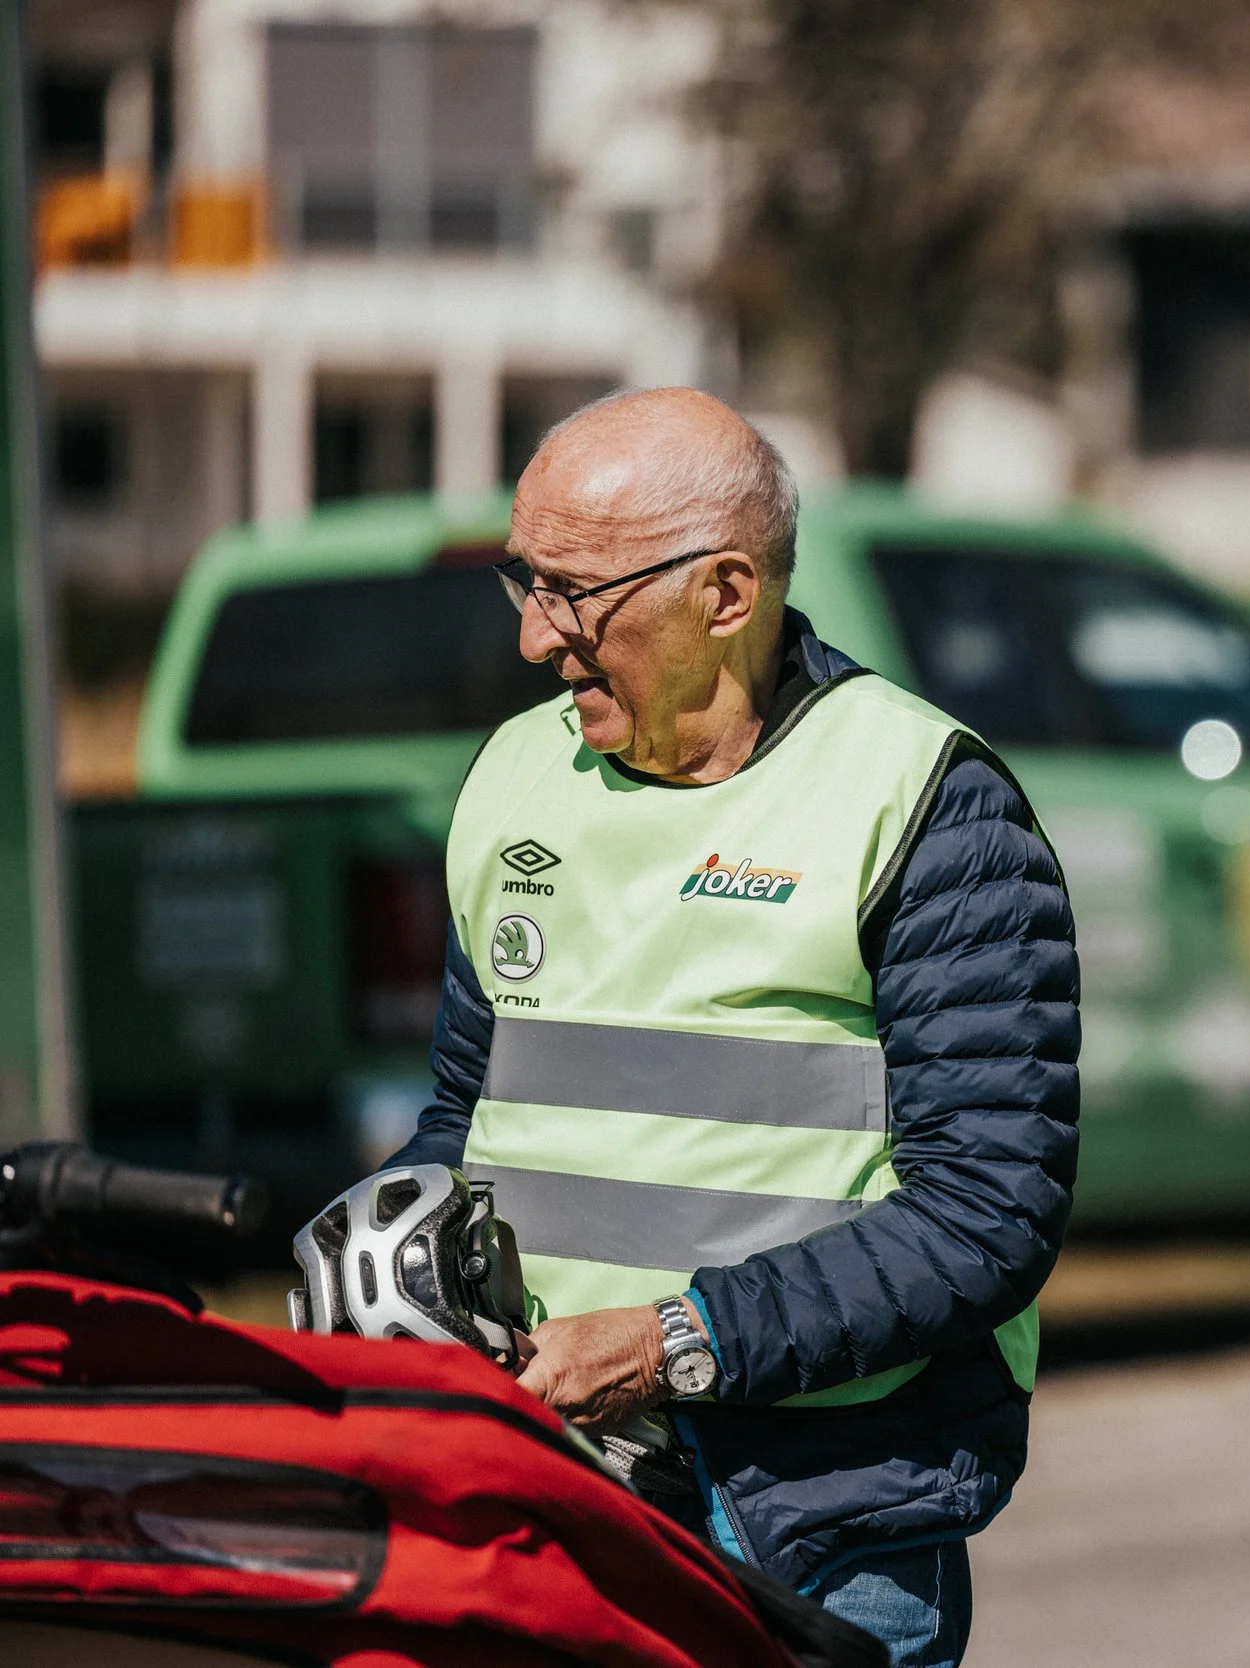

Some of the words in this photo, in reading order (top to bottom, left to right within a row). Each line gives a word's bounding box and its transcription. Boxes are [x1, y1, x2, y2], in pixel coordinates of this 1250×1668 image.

[680, 853, 792, 902] joker
[501, 878, 554, 896] umbro
[494, 993, 540, 1008] KODA
